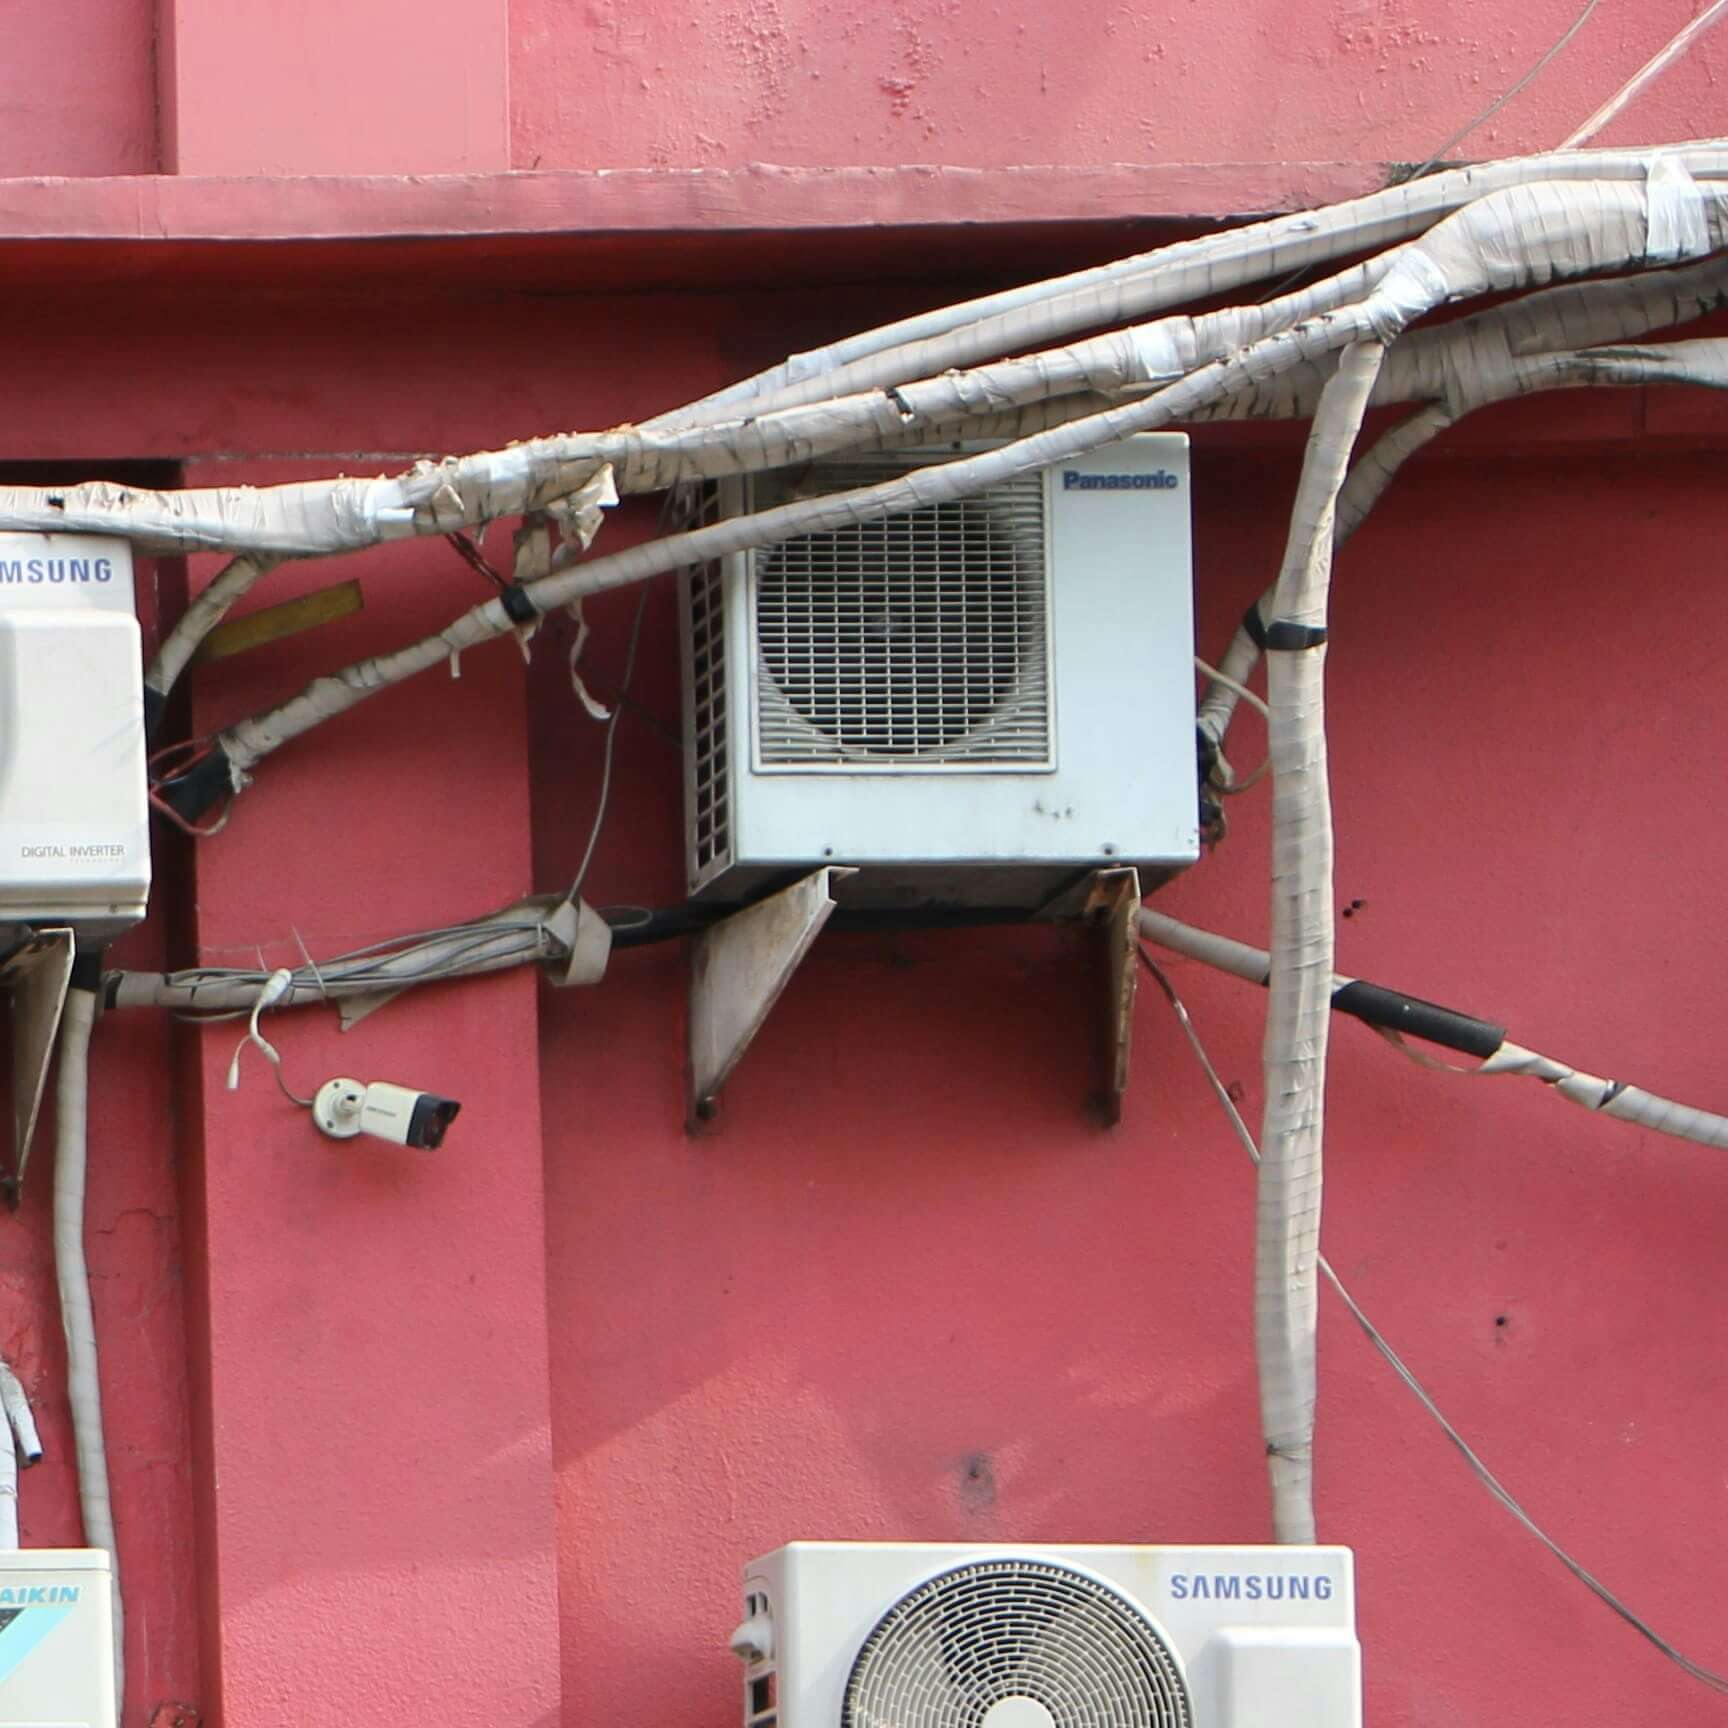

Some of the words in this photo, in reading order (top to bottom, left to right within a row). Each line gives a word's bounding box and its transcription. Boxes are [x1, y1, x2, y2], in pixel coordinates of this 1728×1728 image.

[1063, 468, 1179, 491] Panasonic
[21, 845, 66, 858] DIGITAL
[69, 844, 125, 857] INVERTER
[1170, 1573, 1332, 1600] SAMSUNG
